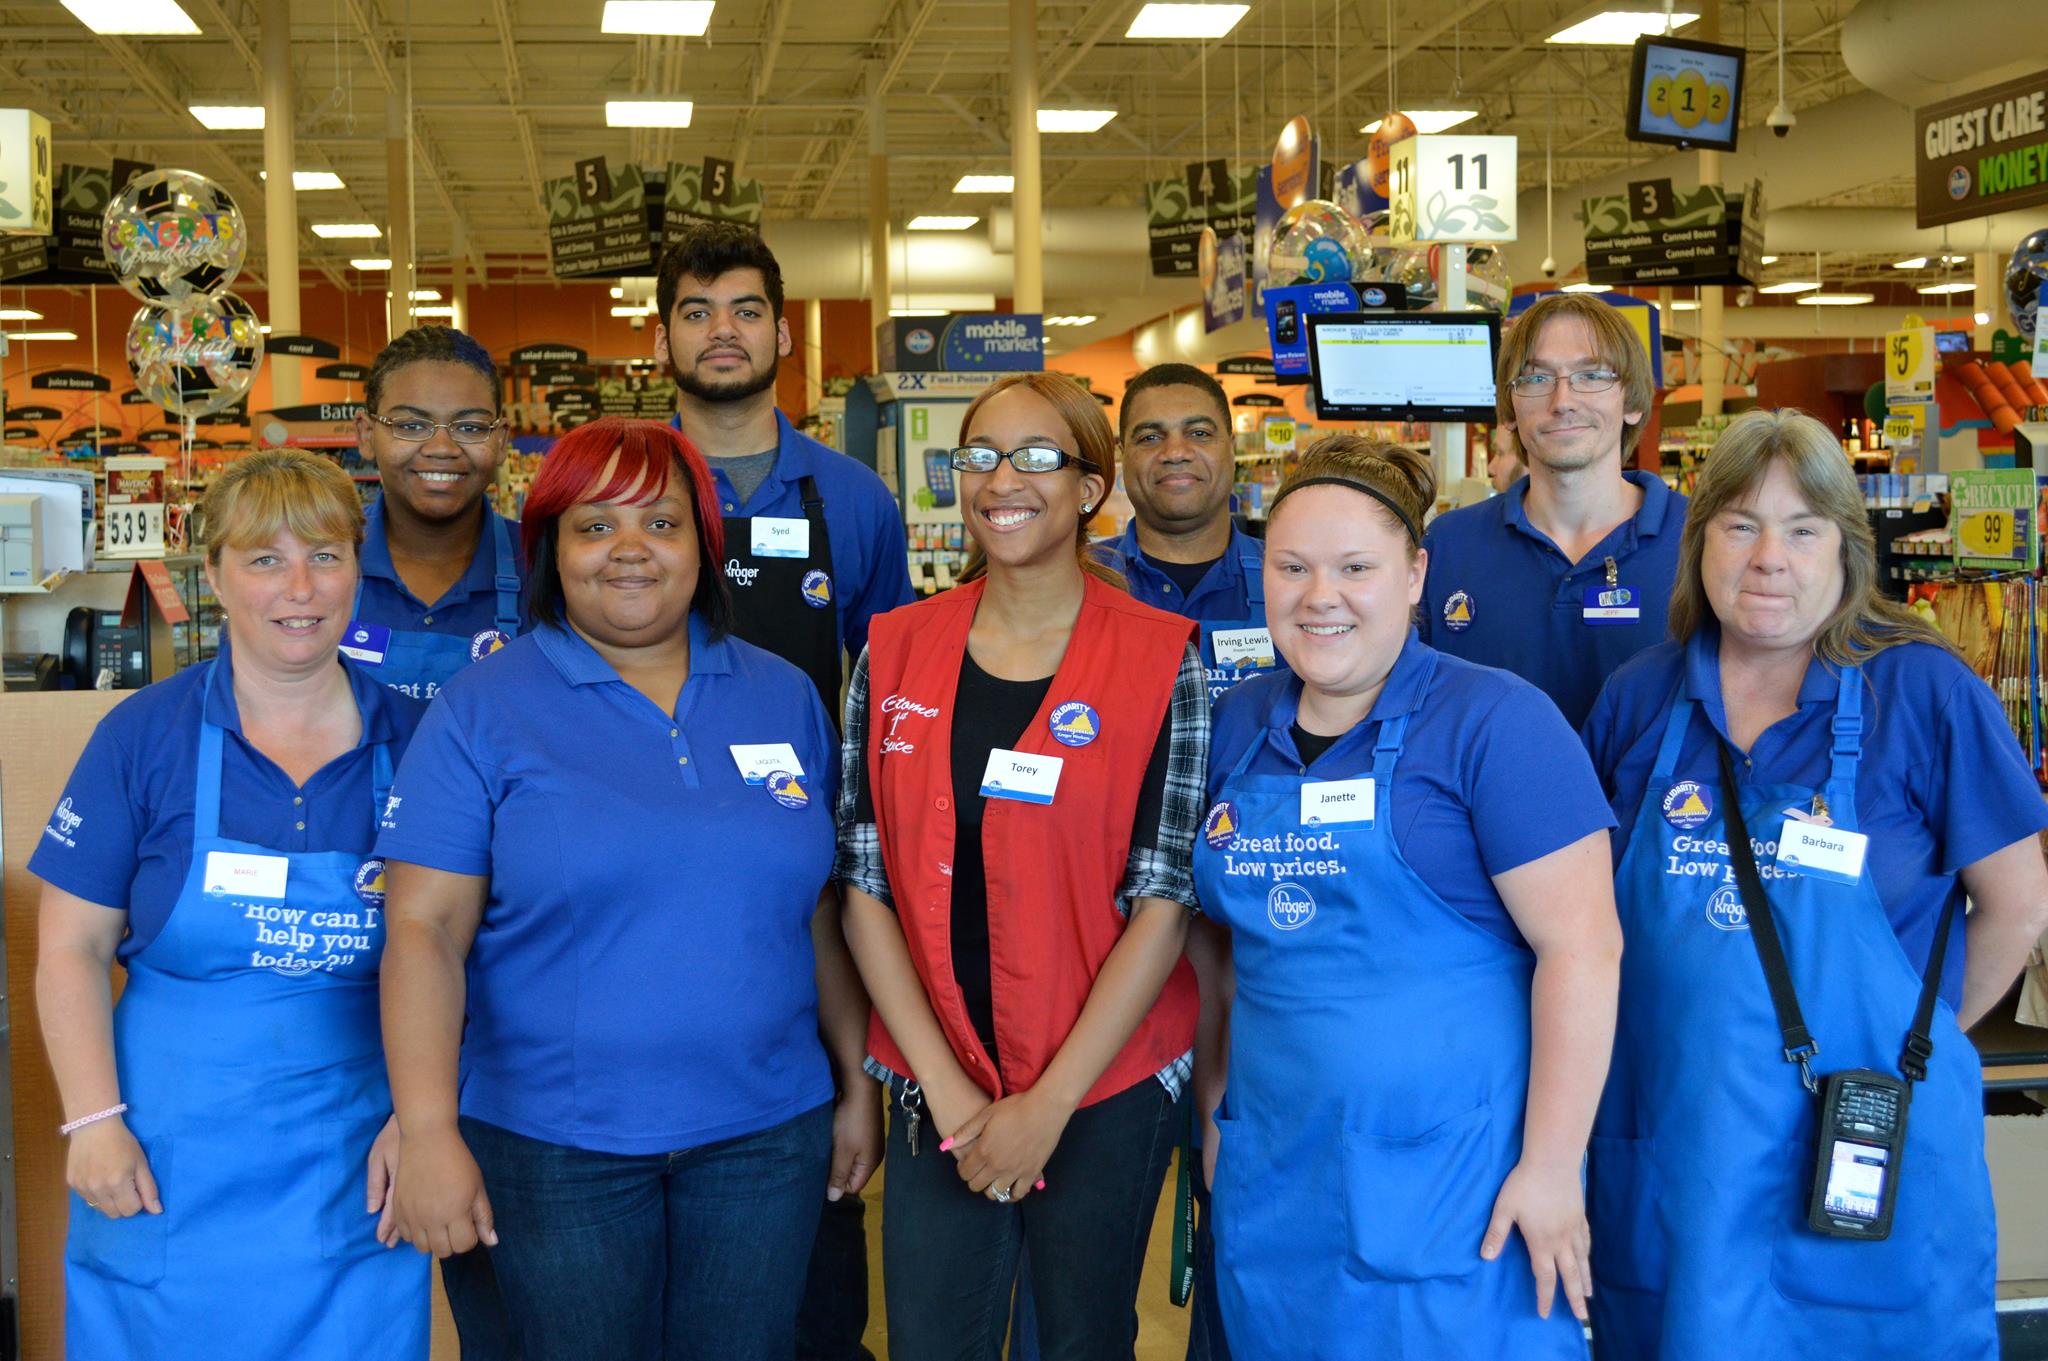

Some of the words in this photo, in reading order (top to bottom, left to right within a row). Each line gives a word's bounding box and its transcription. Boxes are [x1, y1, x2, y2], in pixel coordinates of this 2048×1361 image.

[1656, 88, 1666, 102] 2
[1681, 88, 1695, 112] 1
[1712, 94, 1721, 109] 2
[1926, 108, 1988, 160] GUEST
[1990, 91, 2045, 142] CARE
[36, 135, 48, 178] 10
[1397, 156, 1408, 194] 11
[1447, 154, 1487, 190] 11
[1979, 142, 2048, 196] MONEY
[584, 164, 598, 197] 5
[712, 165, 726, 196] 5
[1642, 185, 1658, 214] 3
[108, 214, 234, 250] CONGRATS
[1662, 232, 1691, 243] Canned
[1693, 229, 1716, 239] Beans
[1587, 240, 1613, 250] Canned
[1666, 248, 1694, 259] Canned
[1696, 246, 1715, 256] Fruit
[1608, 255, 1632, 265] Soups
[1314, 290, 1345, 300] mobile
[965, 320, 1027, 338] mobile
[288, 344, 314, 354] cereal
[984, 337, 1039, 352] market
[521, 351, 542, 360] salad
[544, 350, 577, 362] dressing
[1893, 336, 1909, 376] $5
[898, 374, 927, 390] 2X
[1968, 485, 2033, 507] RECYCLE
[771, 527, 790, 536] Syed
[471, 630, 501, 658] SOLIDARITY
[1217, 637, 1243, 647] Irving
[1244, 635, 1269, 645] Lewis
[1052, 702, 1090, 724] SOLIDARITY
[1011, 762, 1038, 776] Torey
[1321, 793, 1356, 804] Janette
[1664, 782, 1700, 811] SOLIDARITY
[57, 797, 84, 832] Kroger
[1205, 802, 1229, 832] SOLIDARITY
[1285, 832, 1340, 853] food.
[1672, 836, 1731, 855] Grea
[1801, 835, 1844, 852] Barbara
[233, 868, 258, 877] MARIE
[1224, 855, 1267, 877] Low
[1270, 857, 1347, 881] prices.
[1666, 856, 1719, 876] Low
[1274, 890, 1310, 923] Kroger
[1714, 891, 1748, 924] Krog
[311, 912, 361, 929] can
[364, 908, 378, 929] I
[256, 922, 316, 953] help
[322, 934, 371, 955] you
